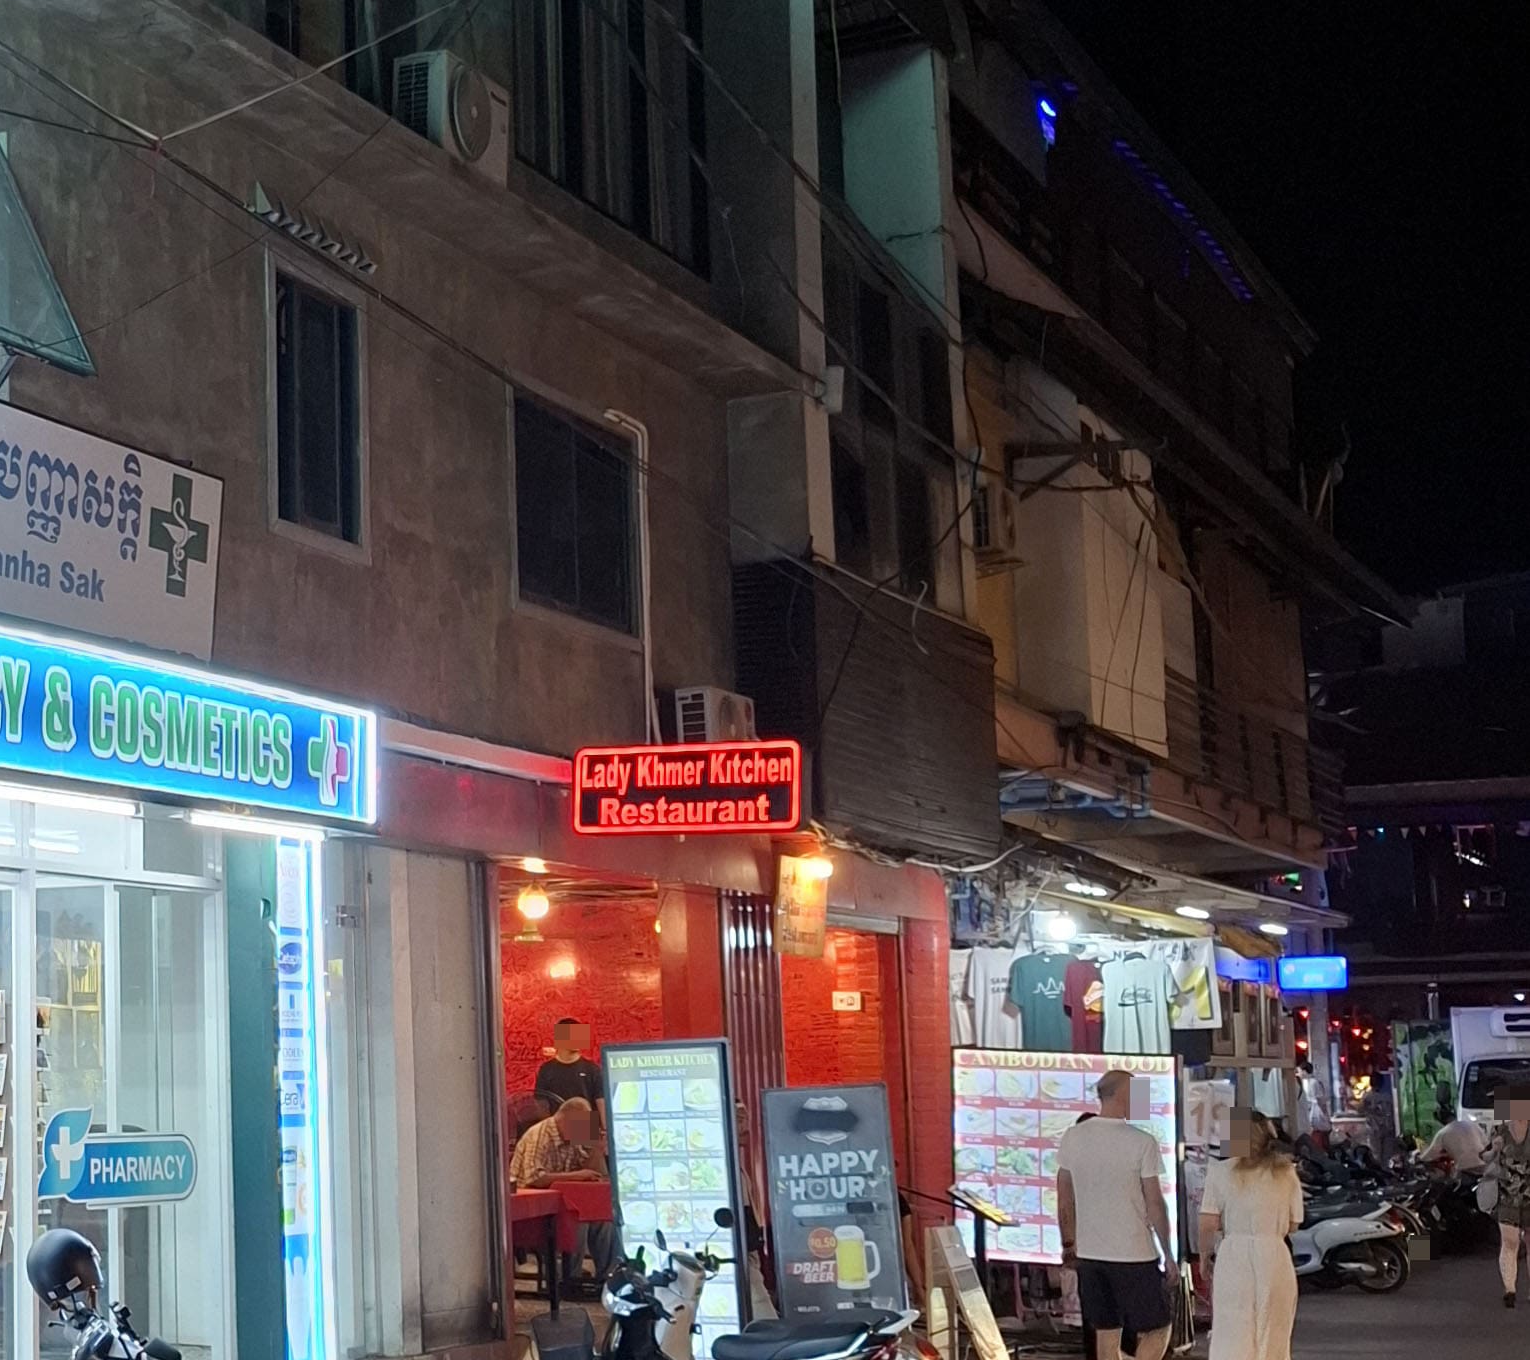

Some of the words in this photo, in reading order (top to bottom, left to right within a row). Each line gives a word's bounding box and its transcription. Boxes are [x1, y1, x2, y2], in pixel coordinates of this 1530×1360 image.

[59, 561, 106, 603] Sak
[42, 666, 77, 751] &
[90, 674, 293, 789] COSMETICS
[581, 755, 631, 796] Lady
[637, 754, 705, 788] Khmer
[709, 751, 792, 785] Kitchen
[600, 793, 770, 826] Restaurant
[609, 1056, 634, 1069] LADY
[637, 1054, 670, 1068] KHMER
[670, 1052, 718, 1067] KITCHEN
[955, 1050, 1094, 1070] CAMBODIAN
[1107, 1056, 1171, 1072] FOOD
[90, 1154, 186, 1185] PHARMACY
[778, 1149, 879, 1178] HAPPY
[793, 1260, 836, 1275] DRAFT
[803, 1271, 835, 1284] BEER
